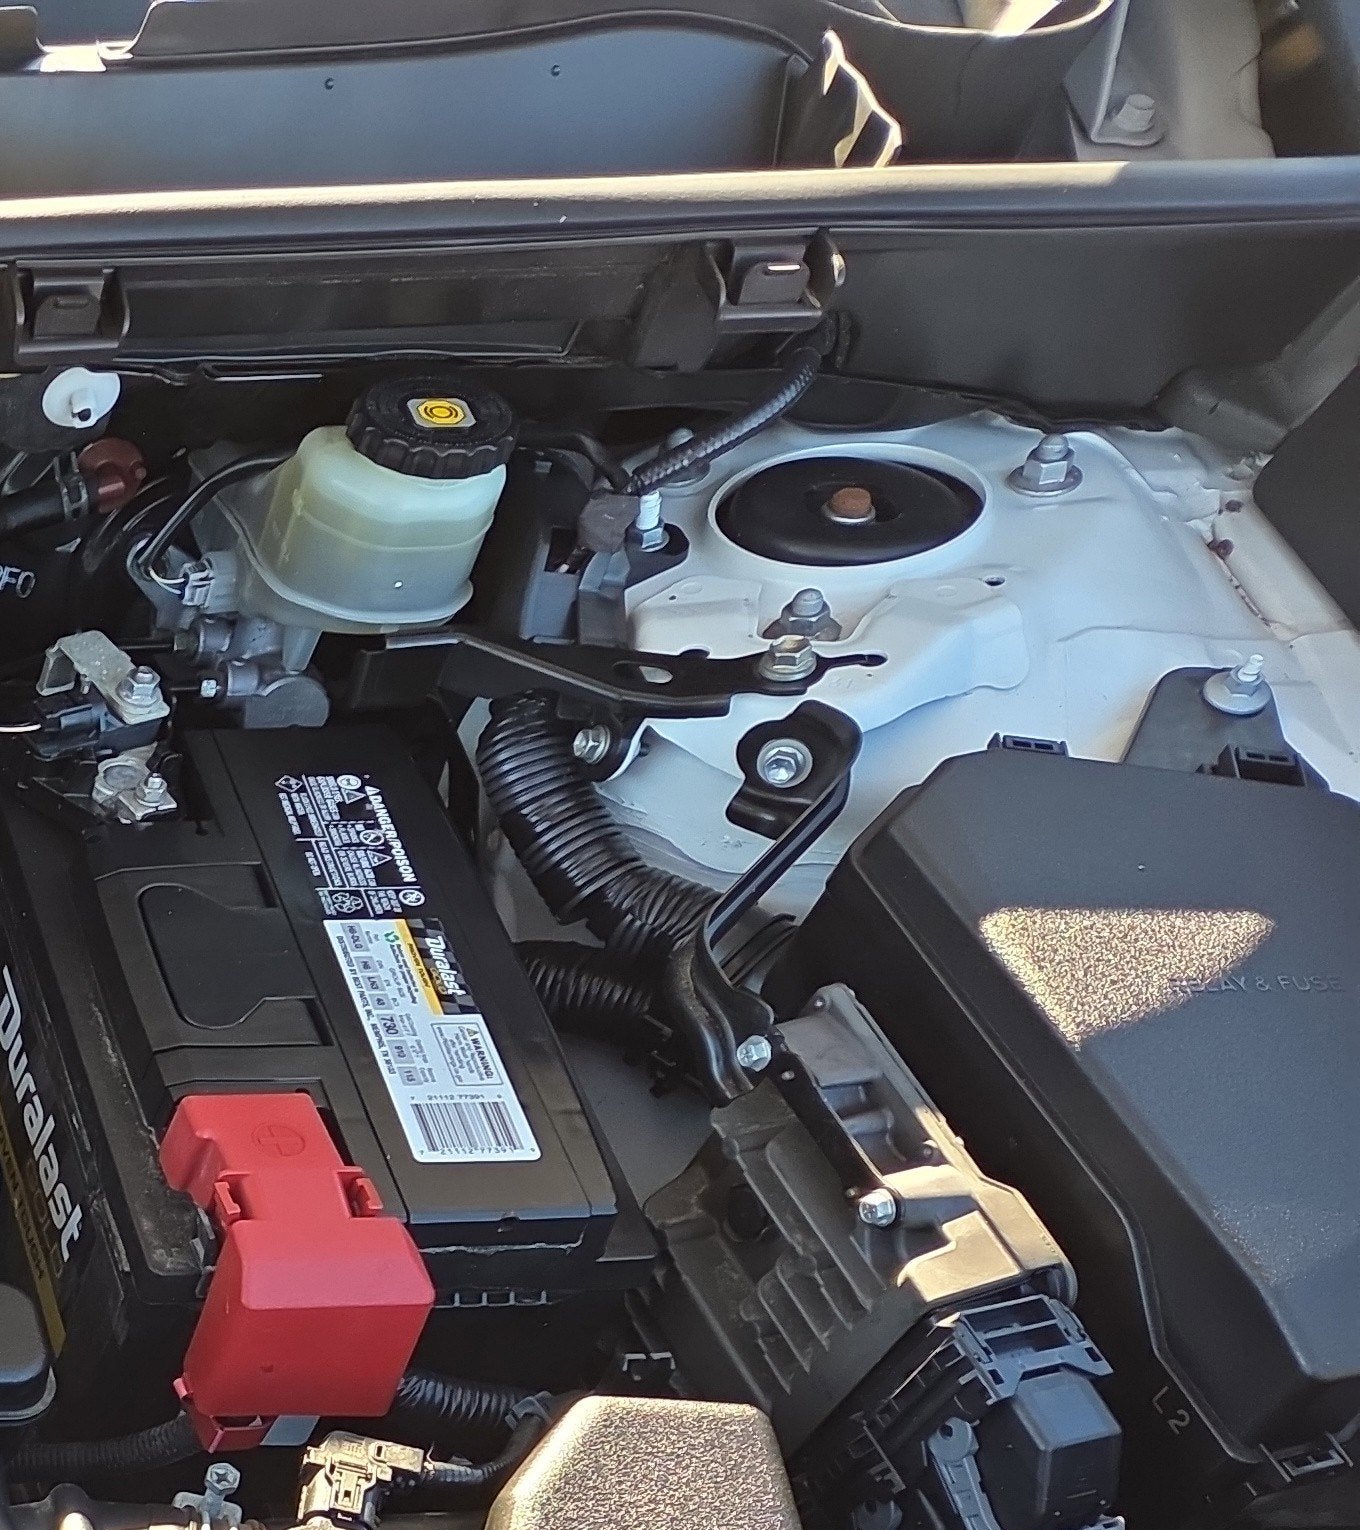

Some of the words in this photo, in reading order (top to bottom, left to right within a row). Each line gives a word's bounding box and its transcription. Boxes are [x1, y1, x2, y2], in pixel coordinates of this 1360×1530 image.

[368, 794, 418, 883] DANGER/POISON
[423, 935, 467, 995] Duralast
[1168, 974, 1247, 993] RELAY
[1255, 974, 1272, 991] &
[1276, 974, 1346, 992] FUSE
[379, 1016, 400, 1034] 730
